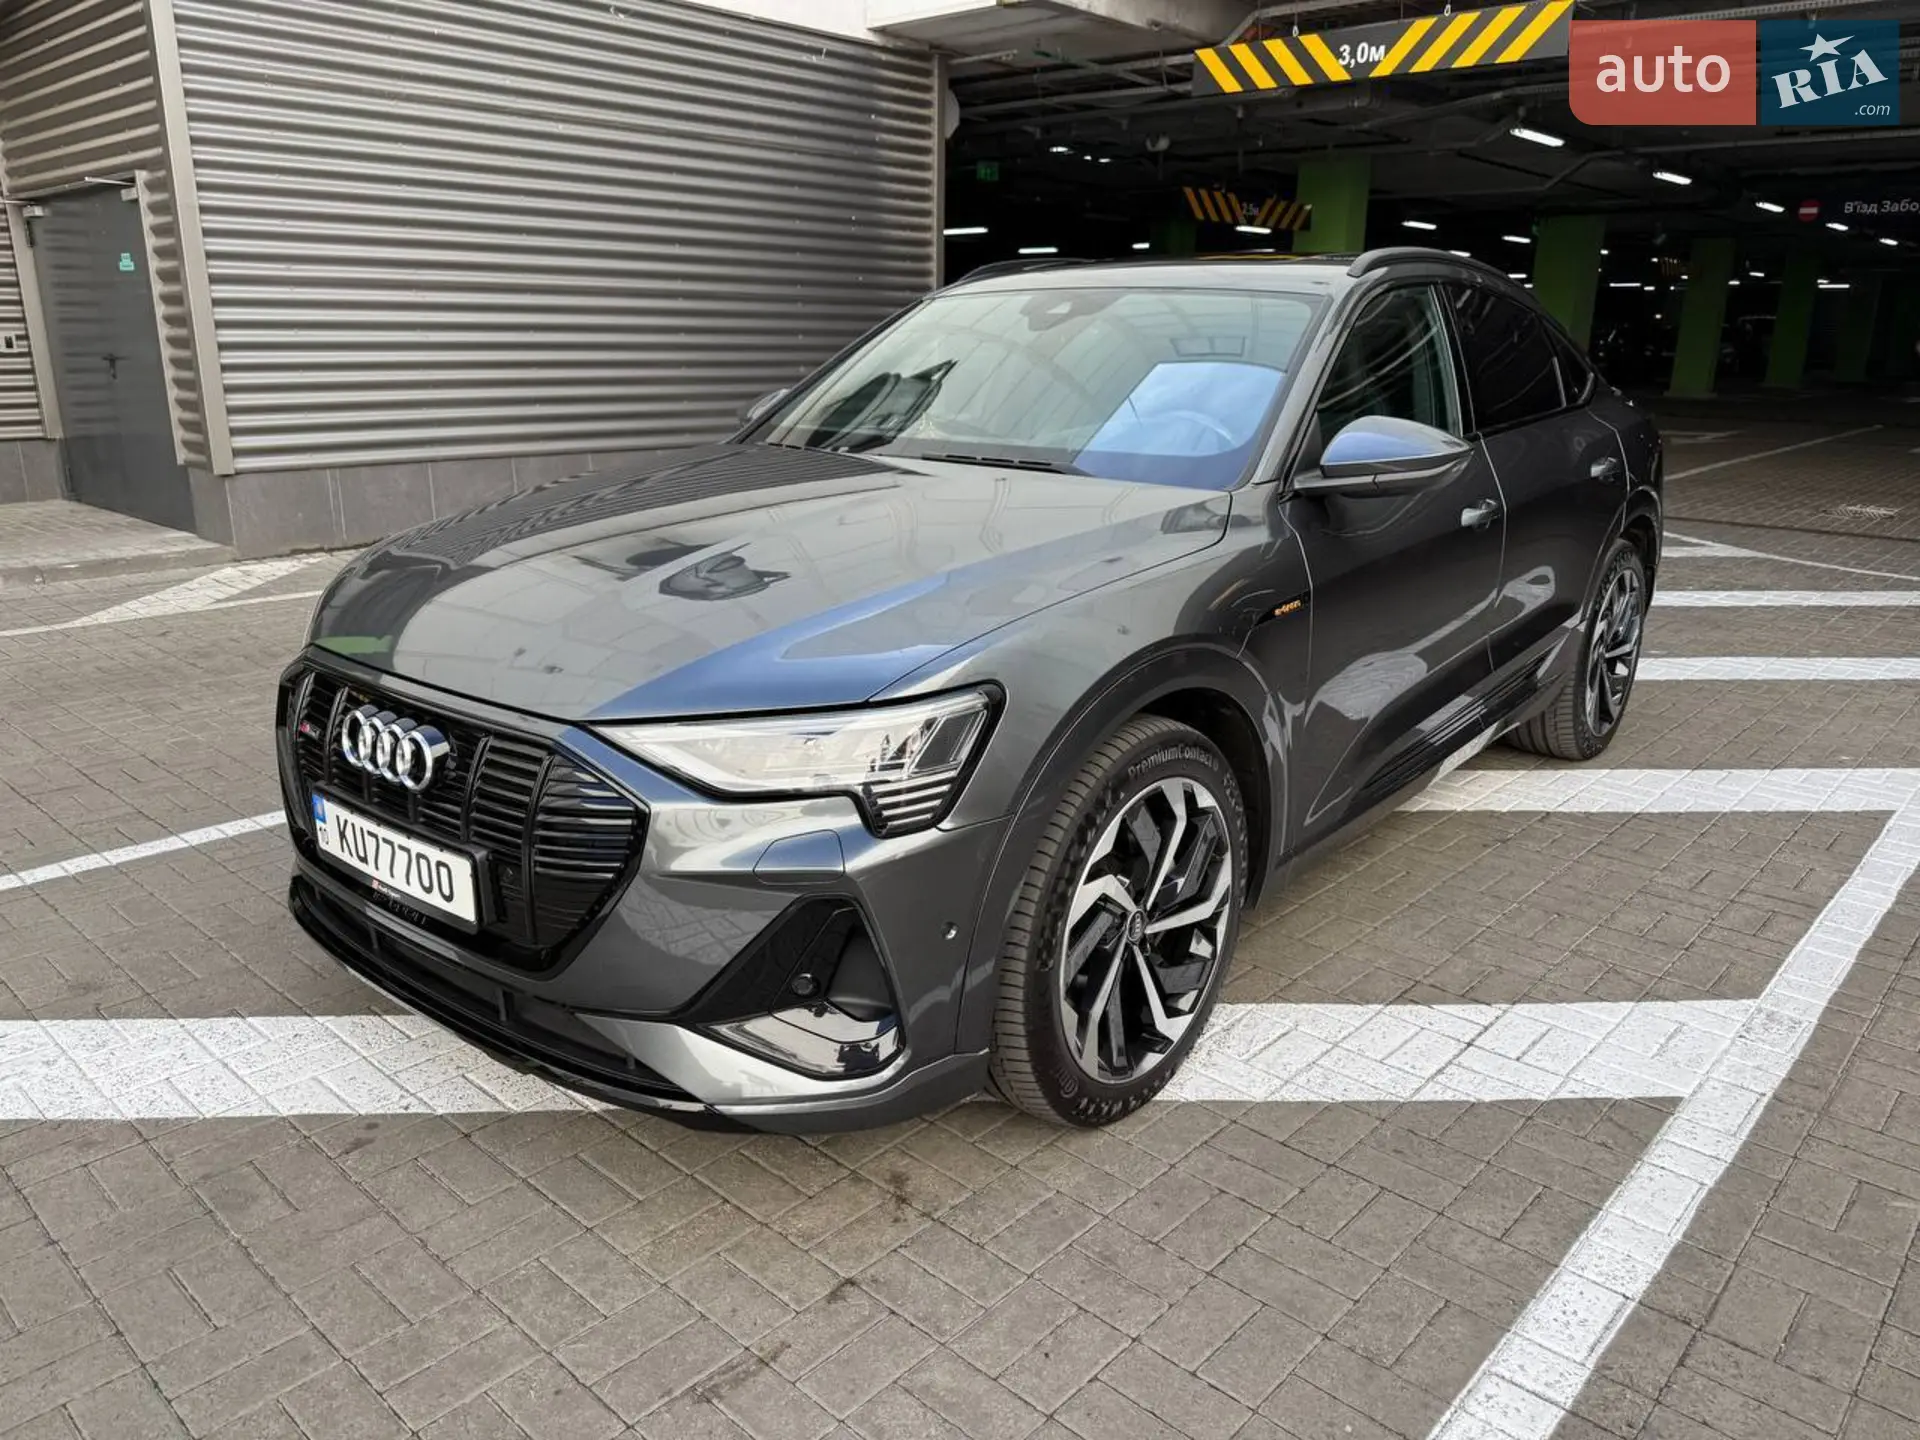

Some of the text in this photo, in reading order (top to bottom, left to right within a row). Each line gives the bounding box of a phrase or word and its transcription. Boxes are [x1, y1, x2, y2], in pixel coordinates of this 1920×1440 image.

[1338, 41, 1386, 69] 3,0м
[1881, 197, 1920, 215] Забо
[336, 814, 454, 903] KU77700
